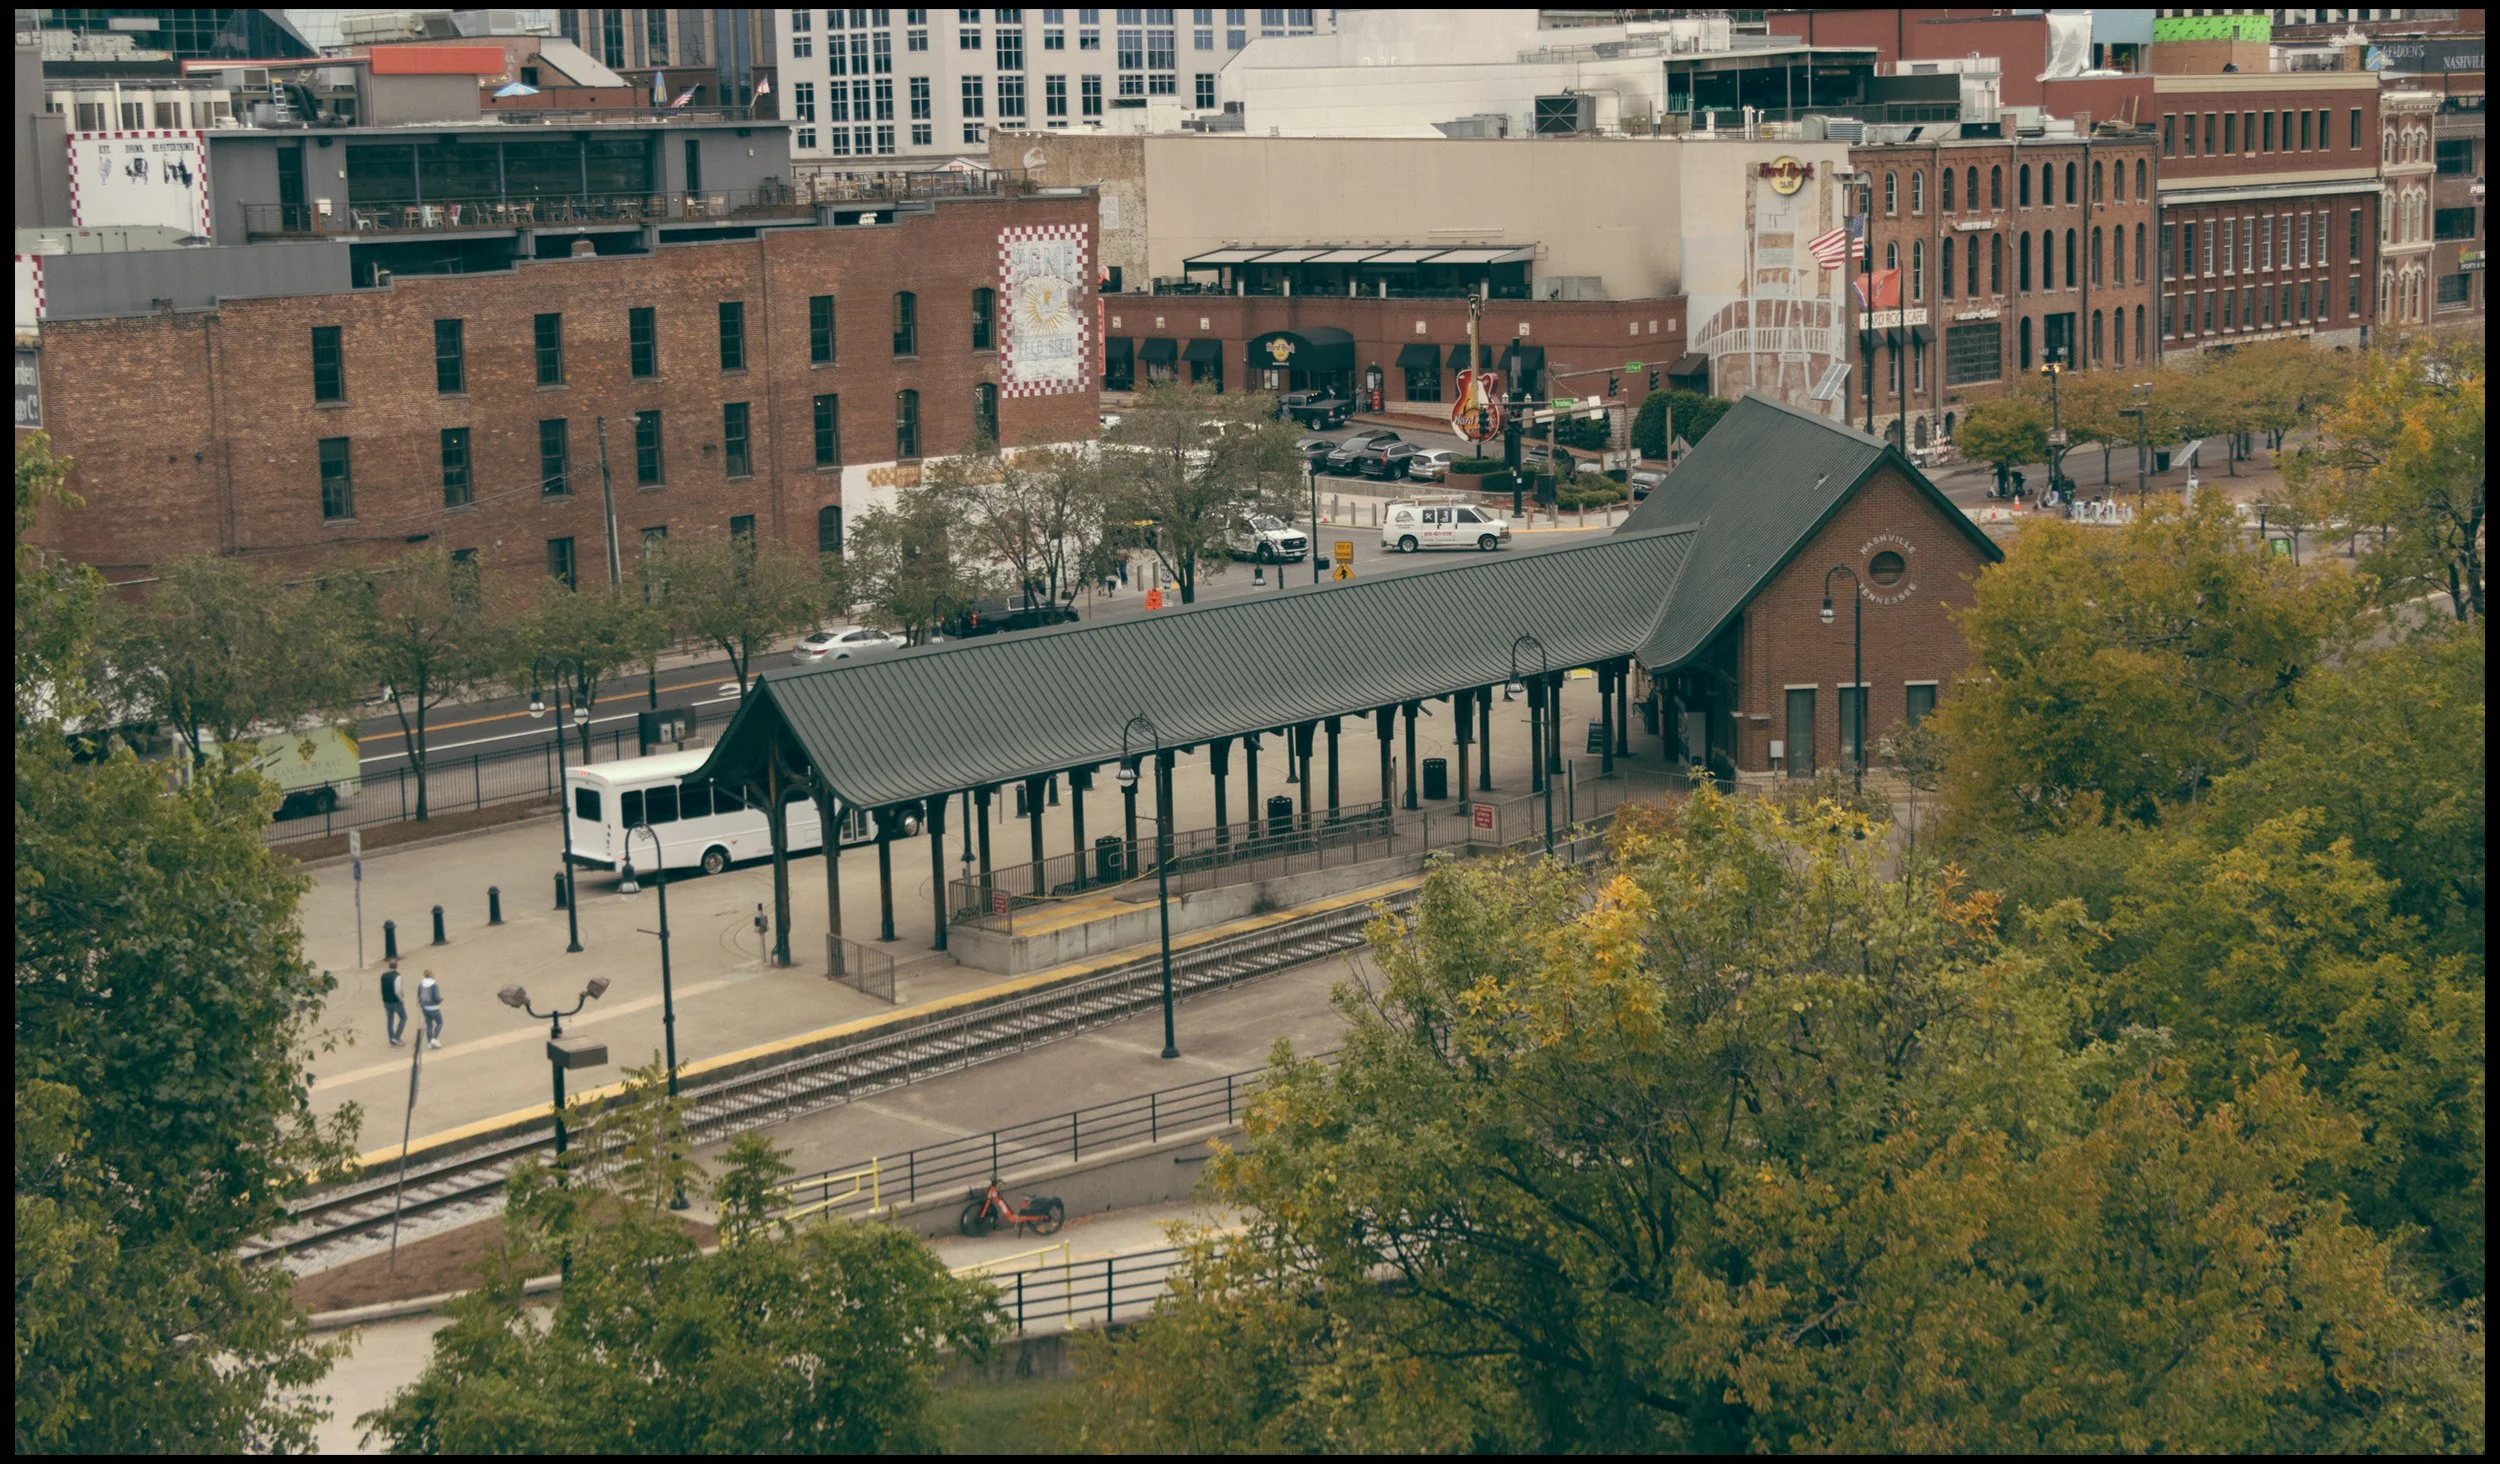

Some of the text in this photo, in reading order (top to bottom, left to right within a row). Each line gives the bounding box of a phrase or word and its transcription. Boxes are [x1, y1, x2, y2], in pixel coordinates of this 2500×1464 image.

[1864, 313, 1884, 328] HRD
[1886, 311, 1905, 325] ROC
[1860, 534, 1917, 555] NASHVILLE
[1858, 583, 1918, 605] TENNESSEE
